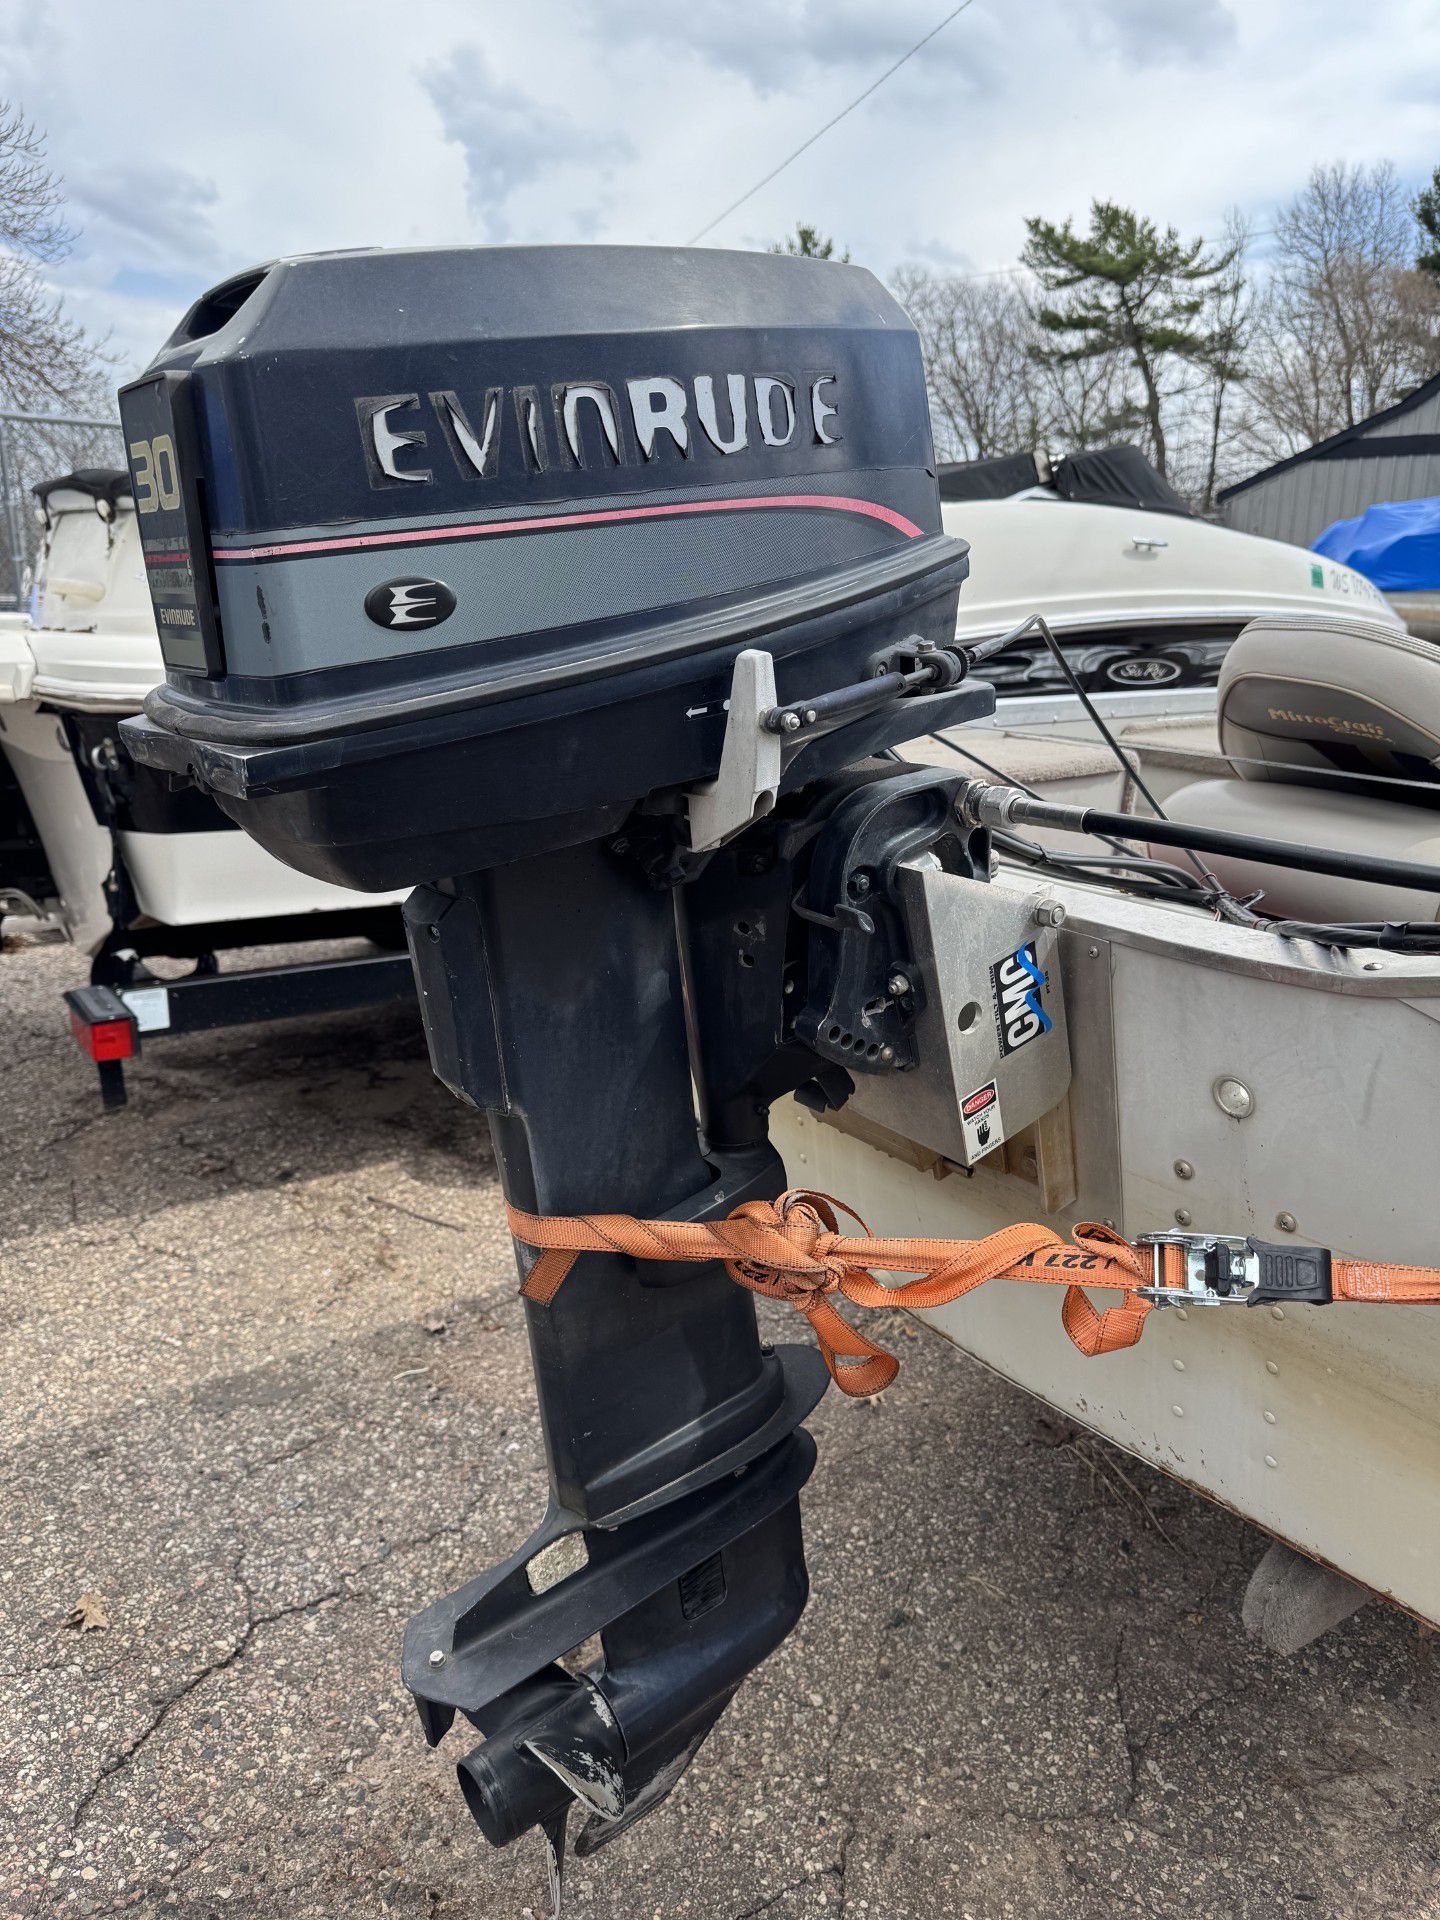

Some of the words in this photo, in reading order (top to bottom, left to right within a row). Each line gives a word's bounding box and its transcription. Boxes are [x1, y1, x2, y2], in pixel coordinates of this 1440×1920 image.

[357, 372, 844, 486] EVINRUDE
[130, 434, 181, 513] 30
[160, 608, 196, 626] EVINRUDE
[999, 950, 1040, 1047] CMC
[995, 1025, 1004, 1059] POWER
[966, 1091, 993, 1112] DANGER
[967, 1113, 983, 1126] WATCH
[983, 1104, 996, 1116] YOUR
[974, 1114, 990, 1127] HANDS
[971, 1150, 982, 1161] AND
[981, 1137, 1002, 1155] FINGERS
[1043, 1253, 1099, 1270] 227
